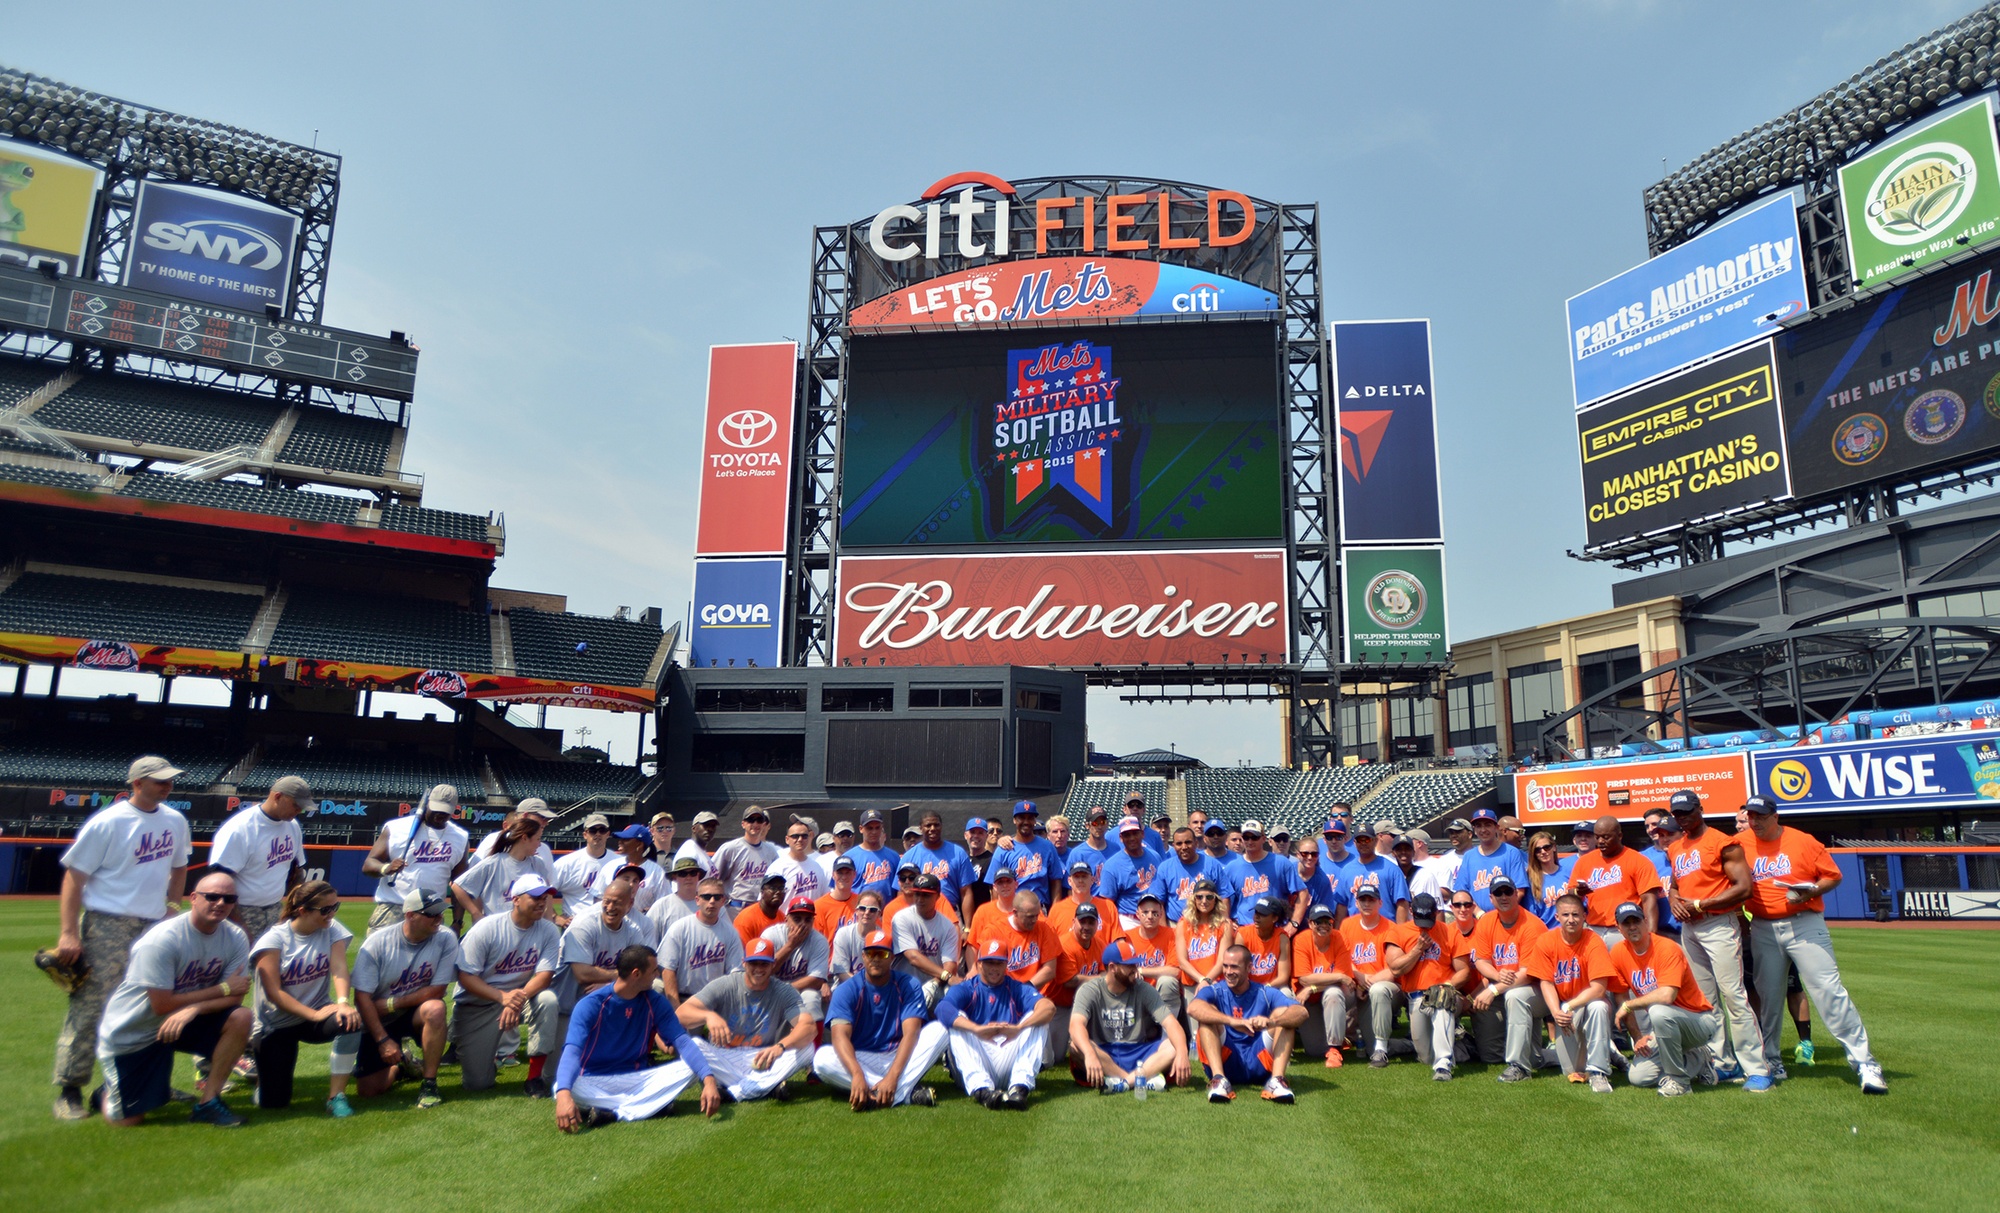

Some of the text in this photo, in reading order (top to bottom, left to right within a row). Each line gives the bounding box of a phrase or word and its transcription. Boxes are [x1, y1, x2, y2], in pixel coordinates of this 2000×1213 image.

[1889, 161, 1944, 195] HAIN
[1867, 161, 1973, 218] CELESTIAL
[869, 187, 1256, 262] citi FIELD
[143, 221, 264, 265] SNY
[1866, 268, 1874, 279] A
[1875, 246, 1928, 272] Healthier
[1929, 237, 1954, 254] Way
[1971, 218, 1995, 237] Life
[139, 261, 277, 299] TV HOME OF THE METS
[907, 275, 993, 316] LET'S
[952, 262, 1112, 327] GO Mets
[1172, 285, 1219, 313] citi
[1575, 237, 1794, 351] Parts Authority
[113, 310, 138, 322] ATL
[169, 302, 332, 340] NATIONAL LEAGUE
[1581, 338, 1618, 358] Auto
[1620, 318, 1665, 341] Parts
[1669, 264, 1787, 317] Superstores
[111, 320, 136, 332] COL
[205, 328, 229, 339] CHC
[207, 318, 230, 329] CIN
[1644, 318, 1696, 347] Answer
[109, 331, 134, 343] MIA
[201, 347, 223, 359] MIL
[1029, 343, 1092, 377] Mets
[1827, 386, 1862, 409] THE
[1868, 366, 1922, 396] METS
[1929, 350, 1971, 376] ARE
[1364, 384, 1426, 397] DELTA
[996, 380, 1119, 423] MILITARY
[995, 400, 1120, 448] SOFTBALL
[1592, 405, 1688, 451] EMPIRE
[1642, 417, 1703, 445] CASINO
[1022, 430, 1095, 459] CLASSIC
[710, 453, 782, 468] TOYOTA
[1044, 455, 1074, 469] 2015
[1602, 434, 1758, 499] MANHATTAN'S
[716, 469, 776, 478] Let's Go Places
[1589, 451, 1781, 523] CLOSEST CASINO
[1374, 577, 1417, 594] OLD DOMINION
[701, 603, 769, 625] GOYA
[844, 580, 1278, 649] Budweiser
[1376, 608, 1417, 623] FREIGHT LINE
[1363, 639, 1387, 647] KEEP
[1411, 632, 1441, 640] WORLD
[84, 648, 132, 666] Mets
[423, 676, 461, 693] Mets
[572, 685, 620, 699] citi FIELD
[1893, 711, 1912, 723] citi
[1975, 703, 1996, 715] citi
[1976, 750, 1998, 761] WISE
[1606, 771, 1734, 788] FIRST PERK: A FREE BEVERAGE
[1819, 752, 1941, 799] WISE
[1545, 781, 1599, 798] DUNKIN'
[1631, 788, 1648, 796] Enroll
[321, 800, 368, 816] Deck
[1546, 795, 1596, 810] DONUTS
[134, 829, 175, 857] Mets
[267, 834, 294, 862] Mets
[413, 840, 453, 857] Mets
[429, 854, 452, 863] ARMY
[863, 859, 891, 878] Mets
[922, 858, 950, 877] Mets
[1015, 853, 1043, 874] Mets
[1675, 850, 1702, 872] Mets
[1752, 853, 1791, 875] Mets
[793, 871, 818, 889] Mets
[1242, 873, 1270, 894] Mets
[1588, 864, 1622, 883] Mets
[1904, 891, 1949, 911] ALTEC
[690, 941, 727, 966] Mets
[1007, 941, 1040, 966] Mets
[1188, 934, 1218, 953] Mets
[1352, 941, 1377, 960] Mets
[1493, 942, 1518, 960] Mets
[281, 953, 330, 981] Mets
[495, 947, 540, 971] Mets
[176, 957, 223, 984] Mets
[390, 961, 434, 990] Mets
[1101, 1008, 1135, 1021] METS
